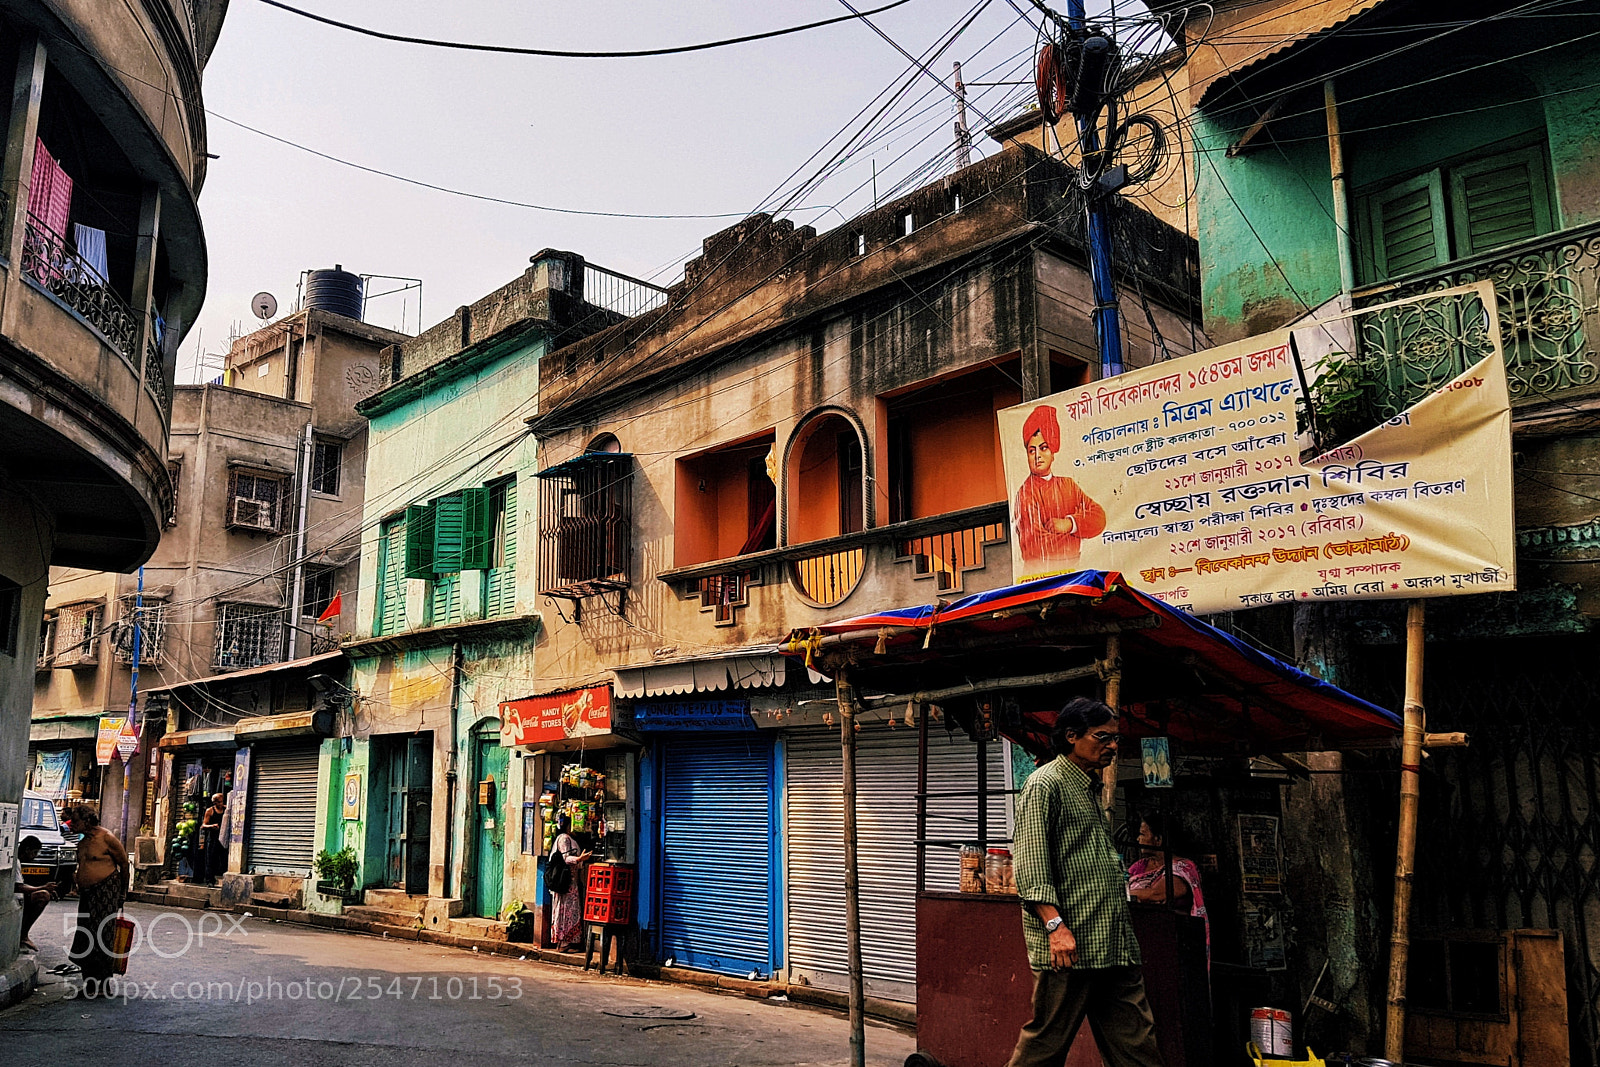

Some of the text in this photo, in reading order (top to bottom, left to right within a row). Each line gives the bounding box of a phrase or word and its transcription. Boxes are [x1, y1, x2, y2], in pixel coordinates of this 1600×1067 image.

[1066, 391, 1093, 421] স্বামী
[1097, 373, 1181, 414] বিবেকানন্দের
[1188, 357, 1242, 388] ১৫৪তম
[1082, 419, 1149, 446] পরিচালনায়
[1162, 398, 1213, 427] মিত্রম
[1132, 443, 1143, 454] দে
[1168, 426, 1215, 445] কলকাতা
[1229, 418, 1255, 432] ৭০০
[1260, 411, 1287, 424] ০১২
[1127, 452, 1187, 477] ছোটদের
[1194, 446, 1227, 461] বসে
[1231, 432, 1287, 452] আঁকো
[1165, 472, 1196, 490] ২১শে
[1200, 459, 1248, 485] জানুয়ারী
[1254, 455, 1293, 472] ২০১৭
[1134, 460, 1410, 519] স্বেচ্ছায় রক্তদান শিবির
[1162, 520, 1194, 534] স্বাস্থ্য
[1199, 510, 1244, 528] পরীক্ষা
[1250, 504, 1294, 522] শিবির
[1369, 488, 1407, 502] কম্বল
[1413, 479, 1465, 499] বিতরণ
[1170, 514, 1364, 556] ২২শে জানুয়ারী ২০১৭ (রবিবার)
[1140, 567, 1165, 584] স্থান
[1195, 551, 1271, 576] বিবেকানন্দ
[1273, 545, 1319, 563] উদ্যান
[1311, 581, 1348, 597] অমিয়
[1353, 580, 1385, 593] বেরা
[1404, 573, 1445, 588] অরূপ
[1345, 561, 1402, 578] সম্পাদক
[541, 707, 560, 717] NANDY
[541, 719, 562, 728] STORES
